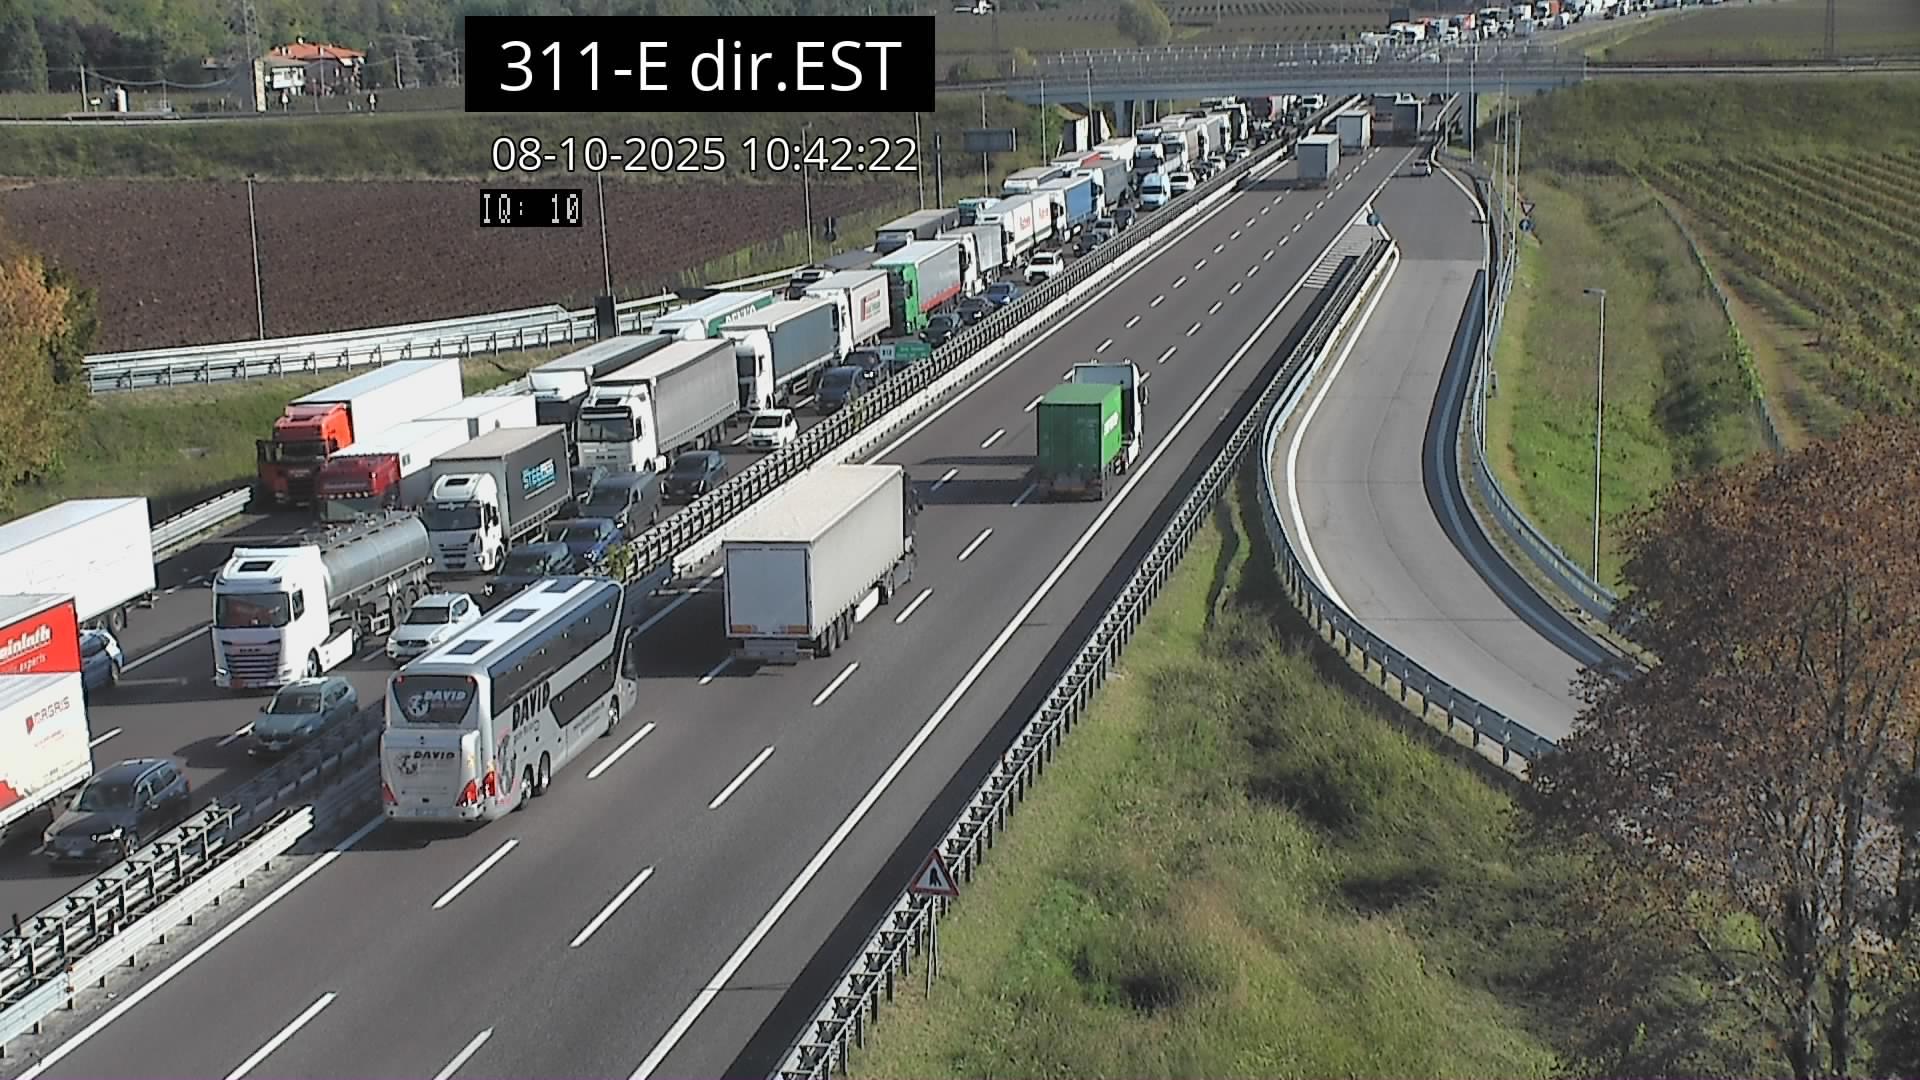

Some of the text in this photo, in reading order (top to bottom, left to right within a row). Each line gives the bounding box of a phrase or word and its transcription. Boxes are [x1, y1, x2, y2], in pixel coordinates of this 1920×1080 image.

[423, 690, 466, 701] DAVID
[512, 681, 550, 731] DAVID
[413, 751, 456, 760] DAVID
